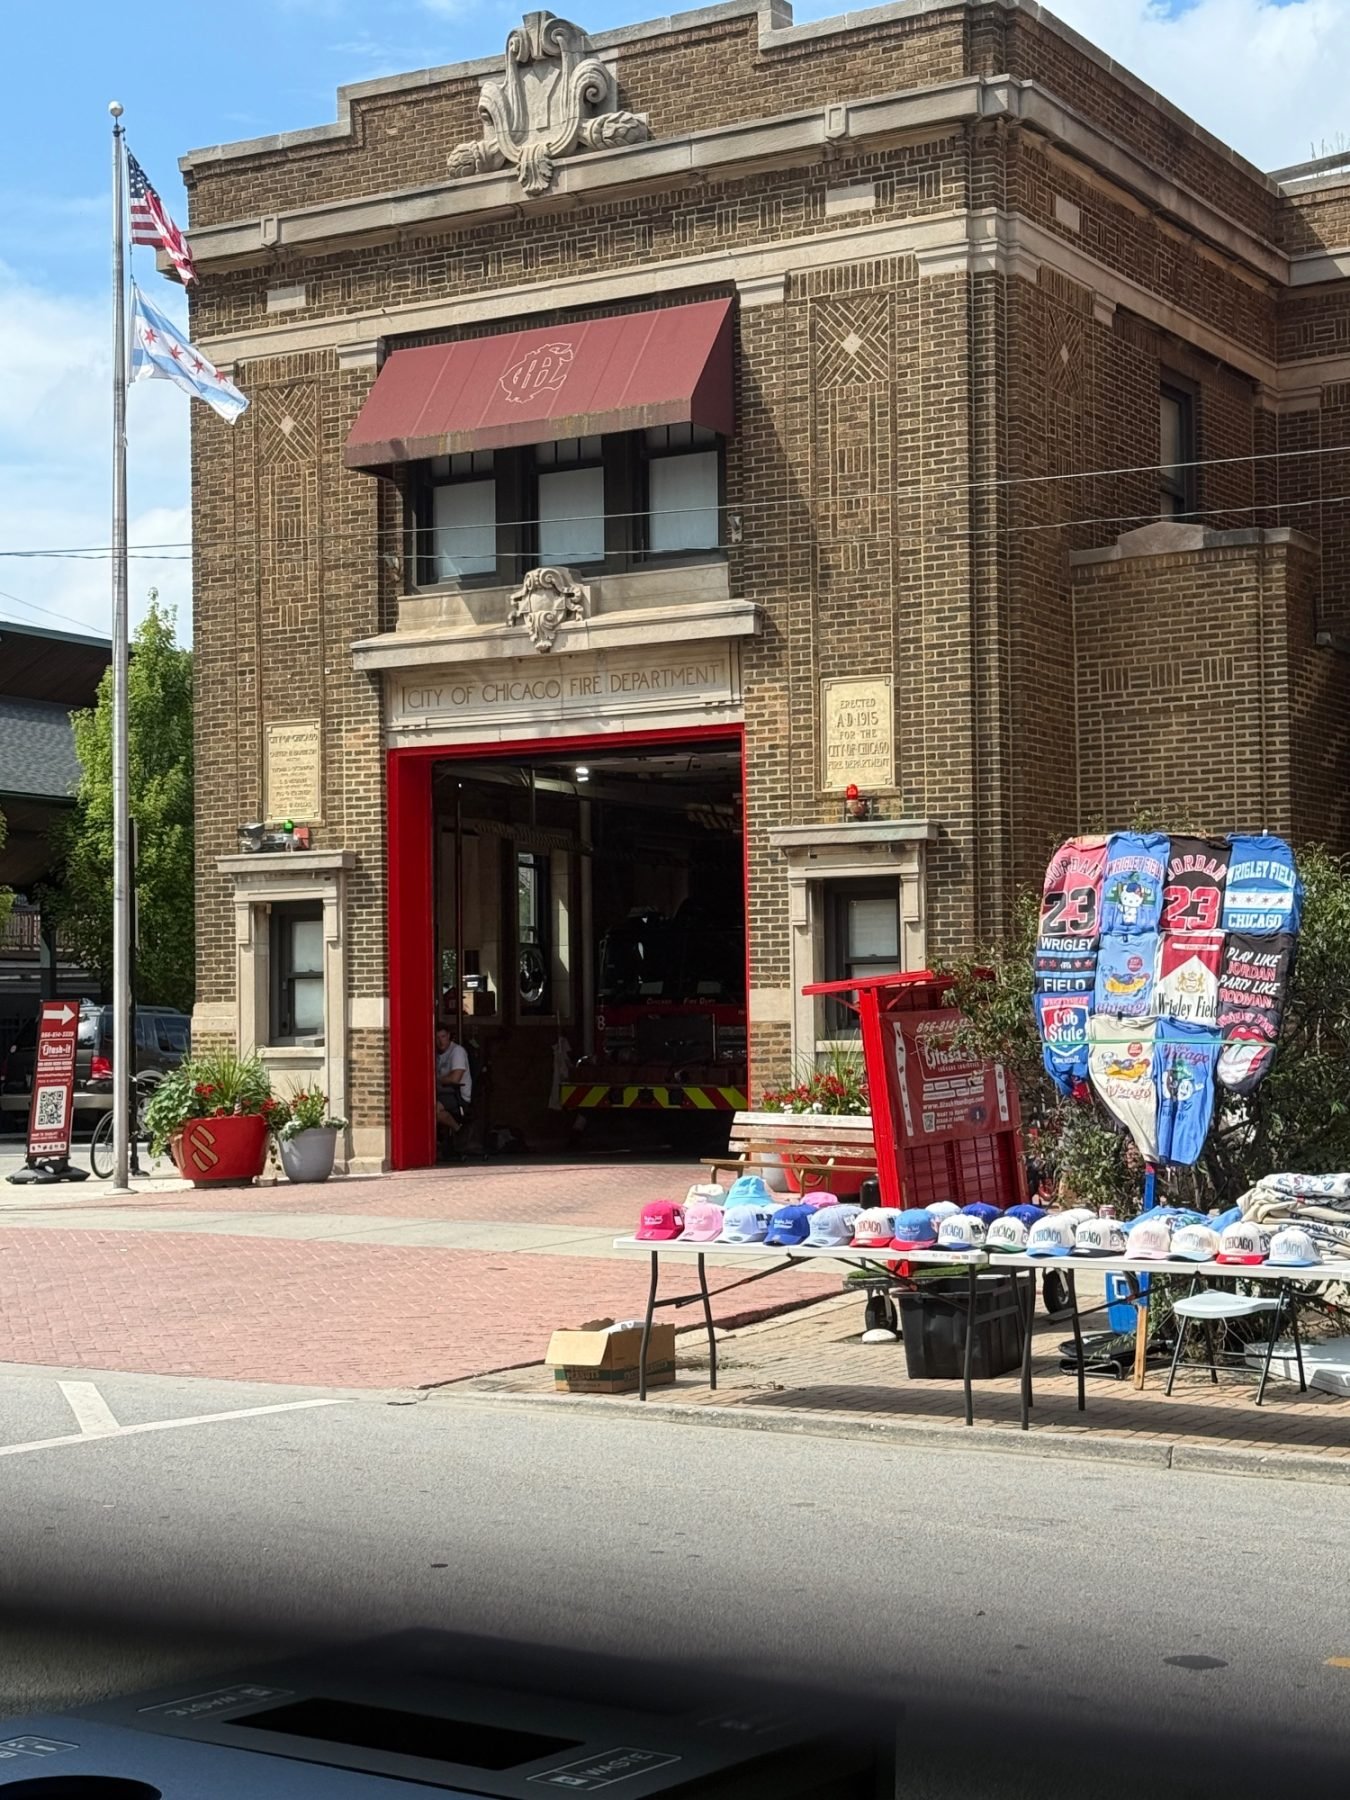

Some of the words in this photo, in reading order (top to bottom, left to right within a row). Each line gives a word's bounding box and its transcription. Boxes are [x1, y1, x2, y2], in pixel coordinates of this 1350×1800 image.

[408, 688, 443, 709] CITY
[451, 685, 474, 706] OF
[482, 679, 561, 703] CHICAGO
[569, 675, 603, 696] FIRE
[610, 664, 720, 692] DEPARTMENT
[840, 698, 876, 709] ERECTED
[840, 730, 856, 740] FOR
[860, 728, 877, 739] THE
[828, 744, 845, 757] CITY
[858, 741, 890, 756] CHICAGO
[845, 758, 890, 769] DEPARTMENT
[1045, 856, 1103, 889] JORDAN
[1167, 854, 1227, 882] JORDAN
[1226, 861, 1269, 886] WRIGLEY
[1269, 861, 1296, 889] FIELD
[1042, 885, 1097, 934] 23
[1162, 885, 1220, 931] 23
[1228, 913, 1282, 928] CHICAGO
[1041, 936, 1094, 951] WRIGLEY
[1227, 947, 1254, 963] PLAY
[1253, 953, 1282, 967] LIKE
[1226, 961, 1276, 981] JORDAN
[1043, 978, 1086, 992] FIELD
[1217, 974, 1251, 991] PARTY
[1251, 981, 1281, 995] LIKE
[1158, 992, 1192, 1019] Wrigley
[1053, 1009, 1079, 1027] Cub
[1049, 1024, 1084, 1043] Style
